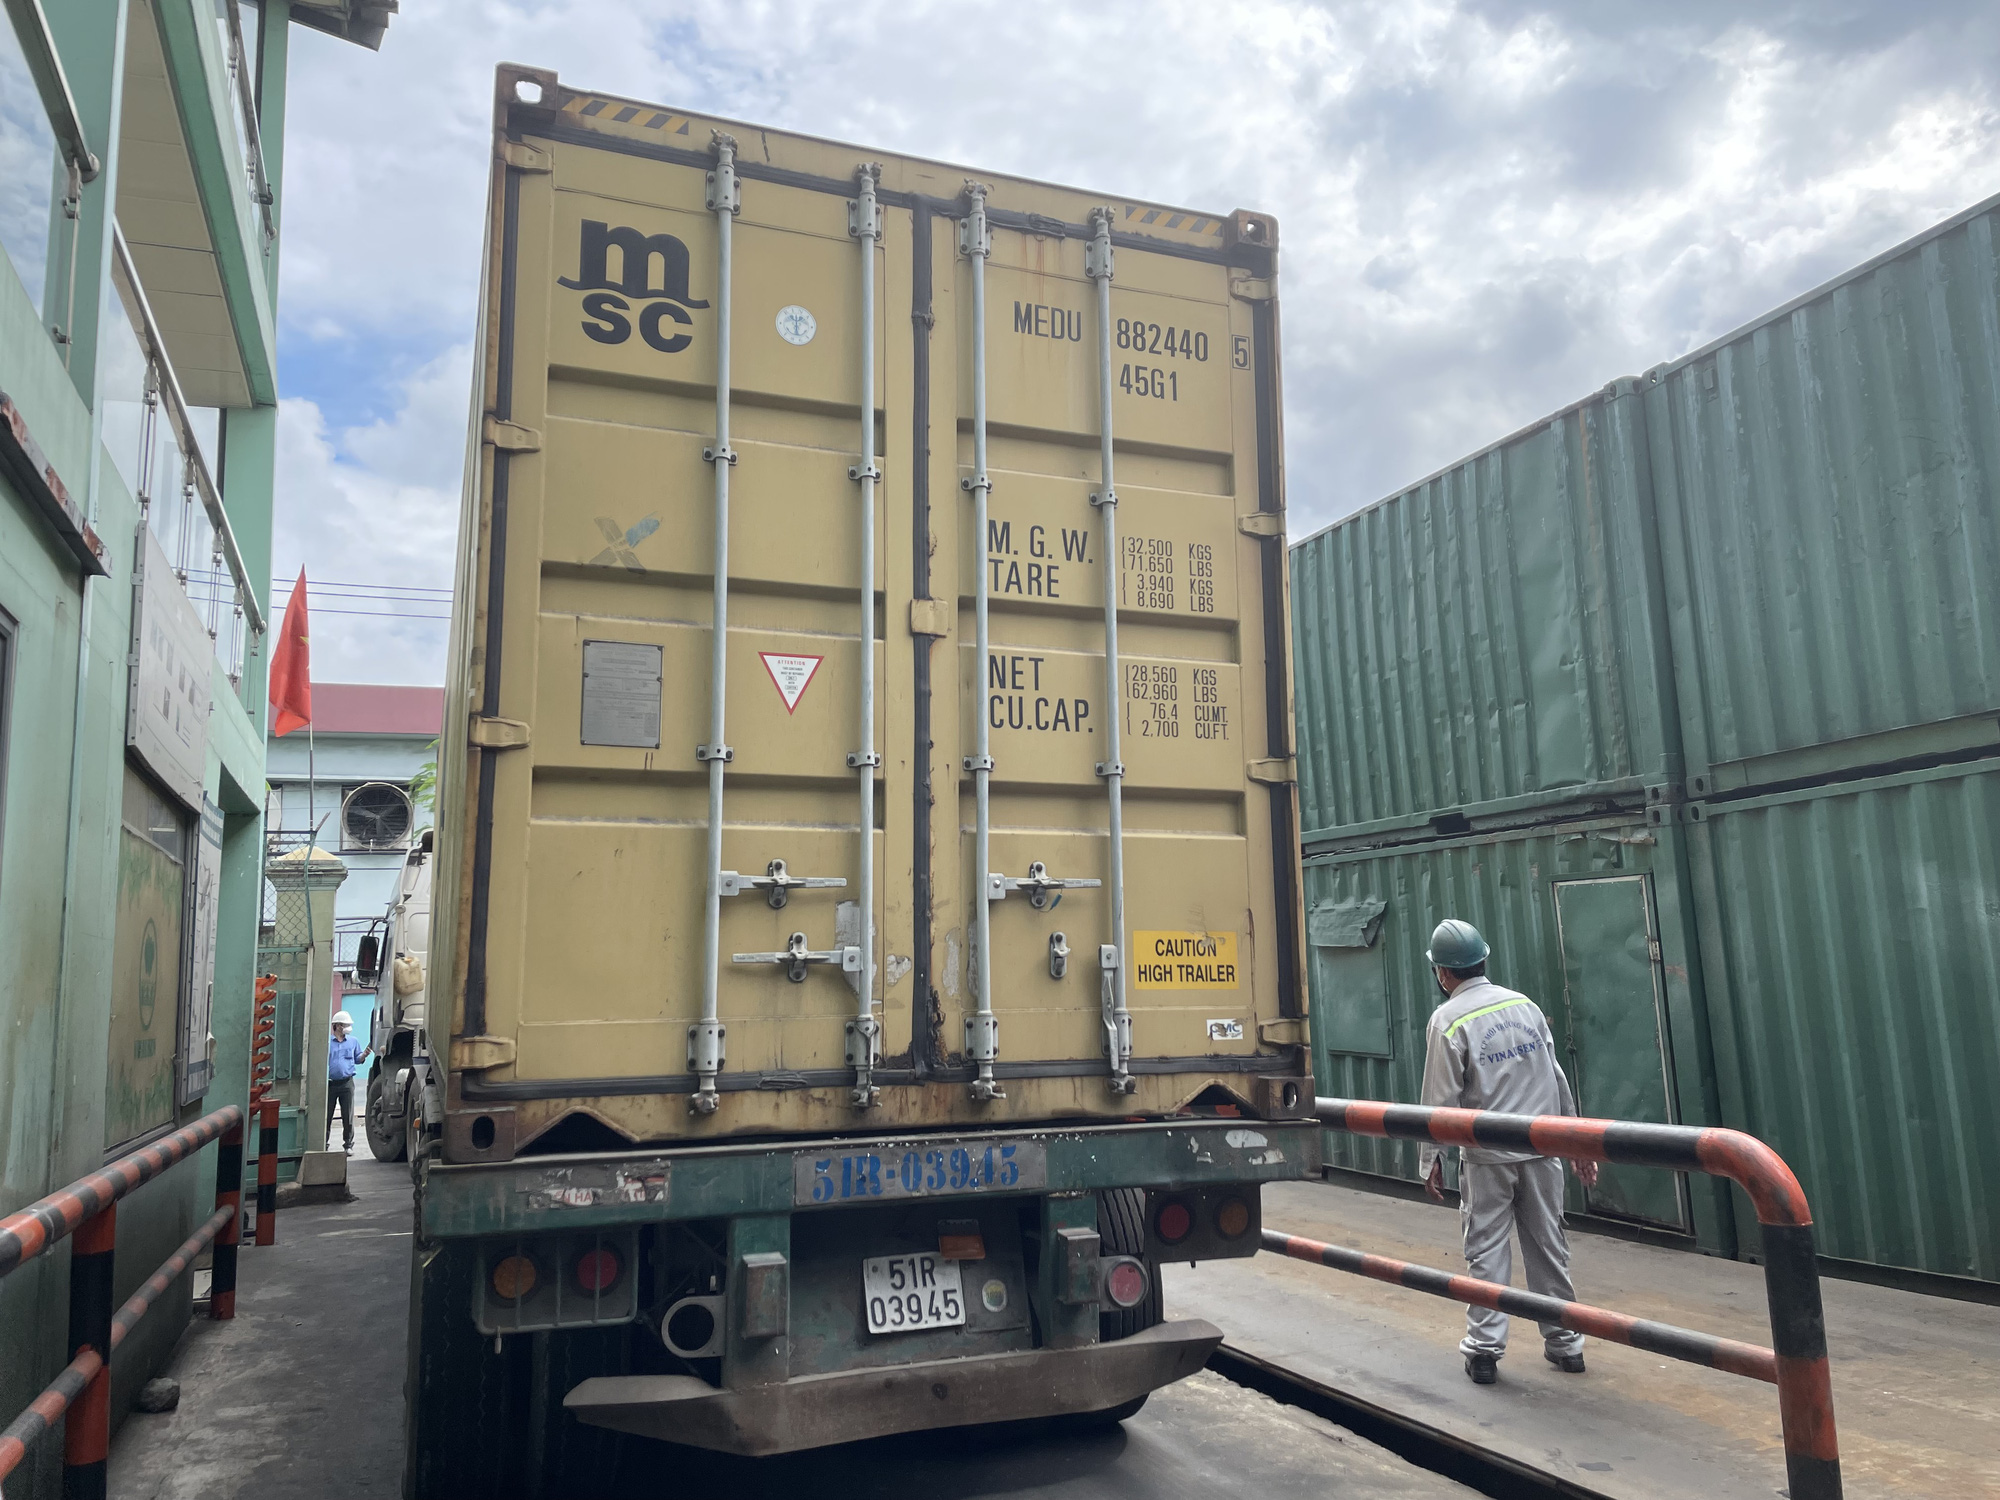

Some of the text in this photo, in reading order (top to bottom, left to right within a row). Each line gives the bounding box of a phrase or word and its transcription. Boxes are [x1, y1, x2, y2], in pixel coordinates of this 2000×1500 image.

[1013, 300, 1249, 368] MEDU 882440 5
[1119, 363, 1178, 402] 45G1
[1127, 536, 1213, 561] 32,500 KGS
[988, 558, 1060, 598] TARE
[1128, 553, 1213, 578] 71,650 LBS
[1136, 573, 1214, 597] 3,940 KGS
[1137, 591, 1214, 613] 8,690 LBS
[988, 654, 1045, 691] NET
[1131, 664, 1217, 686] 28,560 KGS
[1131, 682, 1218, 703] 62,960 LBS
[989, 695, 1094, 733] CU.CAP.
[1149, 702, 1179, 720] 76.4
[1141, 719, 1179, 739] 2,700
[1154, 938, 1217, 957] CAUTION
[1137, 964, 1236, 983] HIGH TRAILER
[888, 1256, 937, 1291] 51R
[869, 1288, 961, 1328] 039.45
